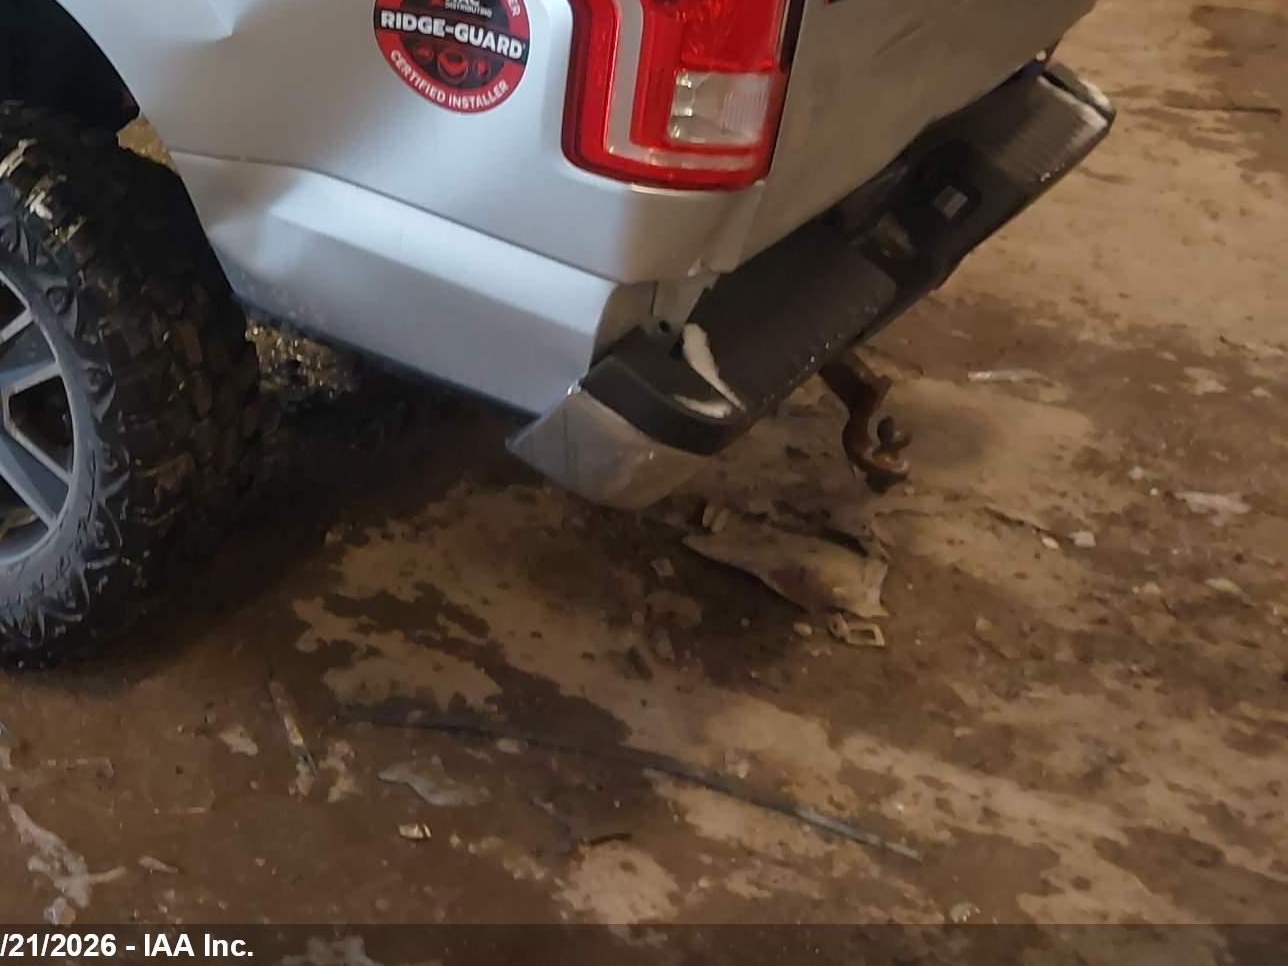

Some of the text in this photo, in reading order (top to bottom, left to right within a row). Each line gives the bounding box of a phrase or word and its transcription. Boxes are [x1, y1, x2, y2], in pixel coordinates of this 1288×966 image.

[380, 10, 523, 60] RIDGE-GUARD
[390, 49, 509, 110] CERTIFIED INSTALLER
